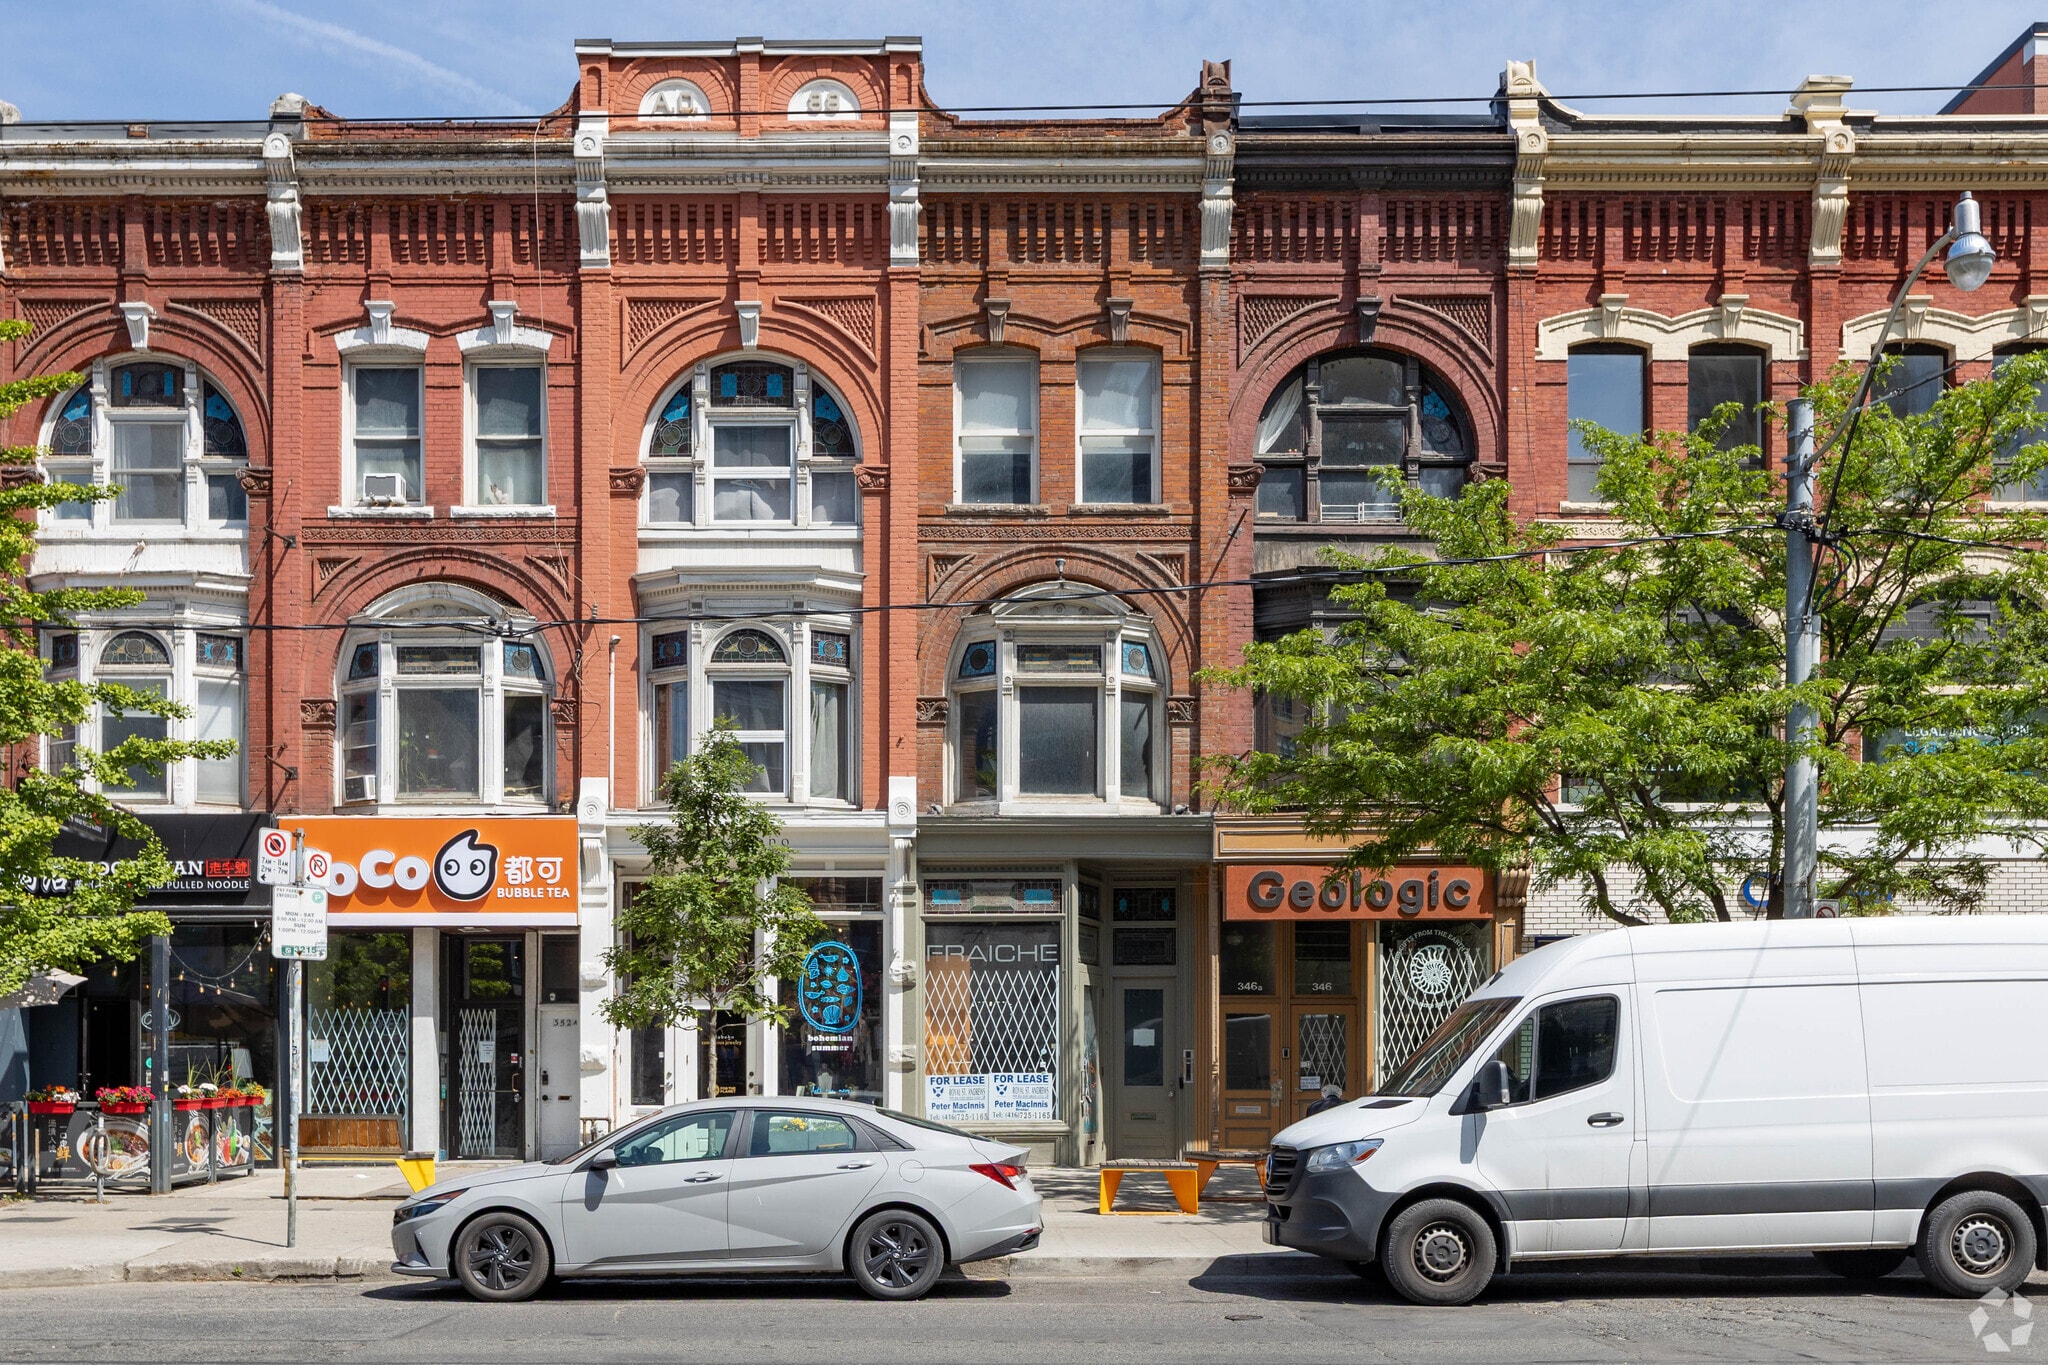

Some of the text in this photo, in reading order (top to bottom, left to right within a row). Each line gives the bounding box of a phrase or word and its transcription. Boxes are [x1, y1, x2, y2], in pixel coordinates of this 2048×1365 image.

[291, 847, 431, 897] oCo
[503, 855, 563, 885] 都可
[166, 880, 204, 889] PULLED
[206, 880, 250, 889] NOODLE
[496, 887, 570, 898] BUBBLE TEA
[1250, 869, 1471, 914] Geologic
[1414, 929, 1433, 939] FROM
[1433, 929, 1448, 938] THE
[926, 943, 1059, 963] FRAICHE
[1237, 982, 1263, 992] 346a
[1312, 982, 1333, 992] 346
[806, 1033, 854, 1043] bohemian
[811, 1043, 850, 1052] summer
[930, 1076, 985, 1086] FOR LEASE
[993, 1074, 1049, 1083] FOR LEASE
[931, 1102, 986, 1110] Peter MacInnis
[1015, 1100, 1049, 1108] MacInnis
